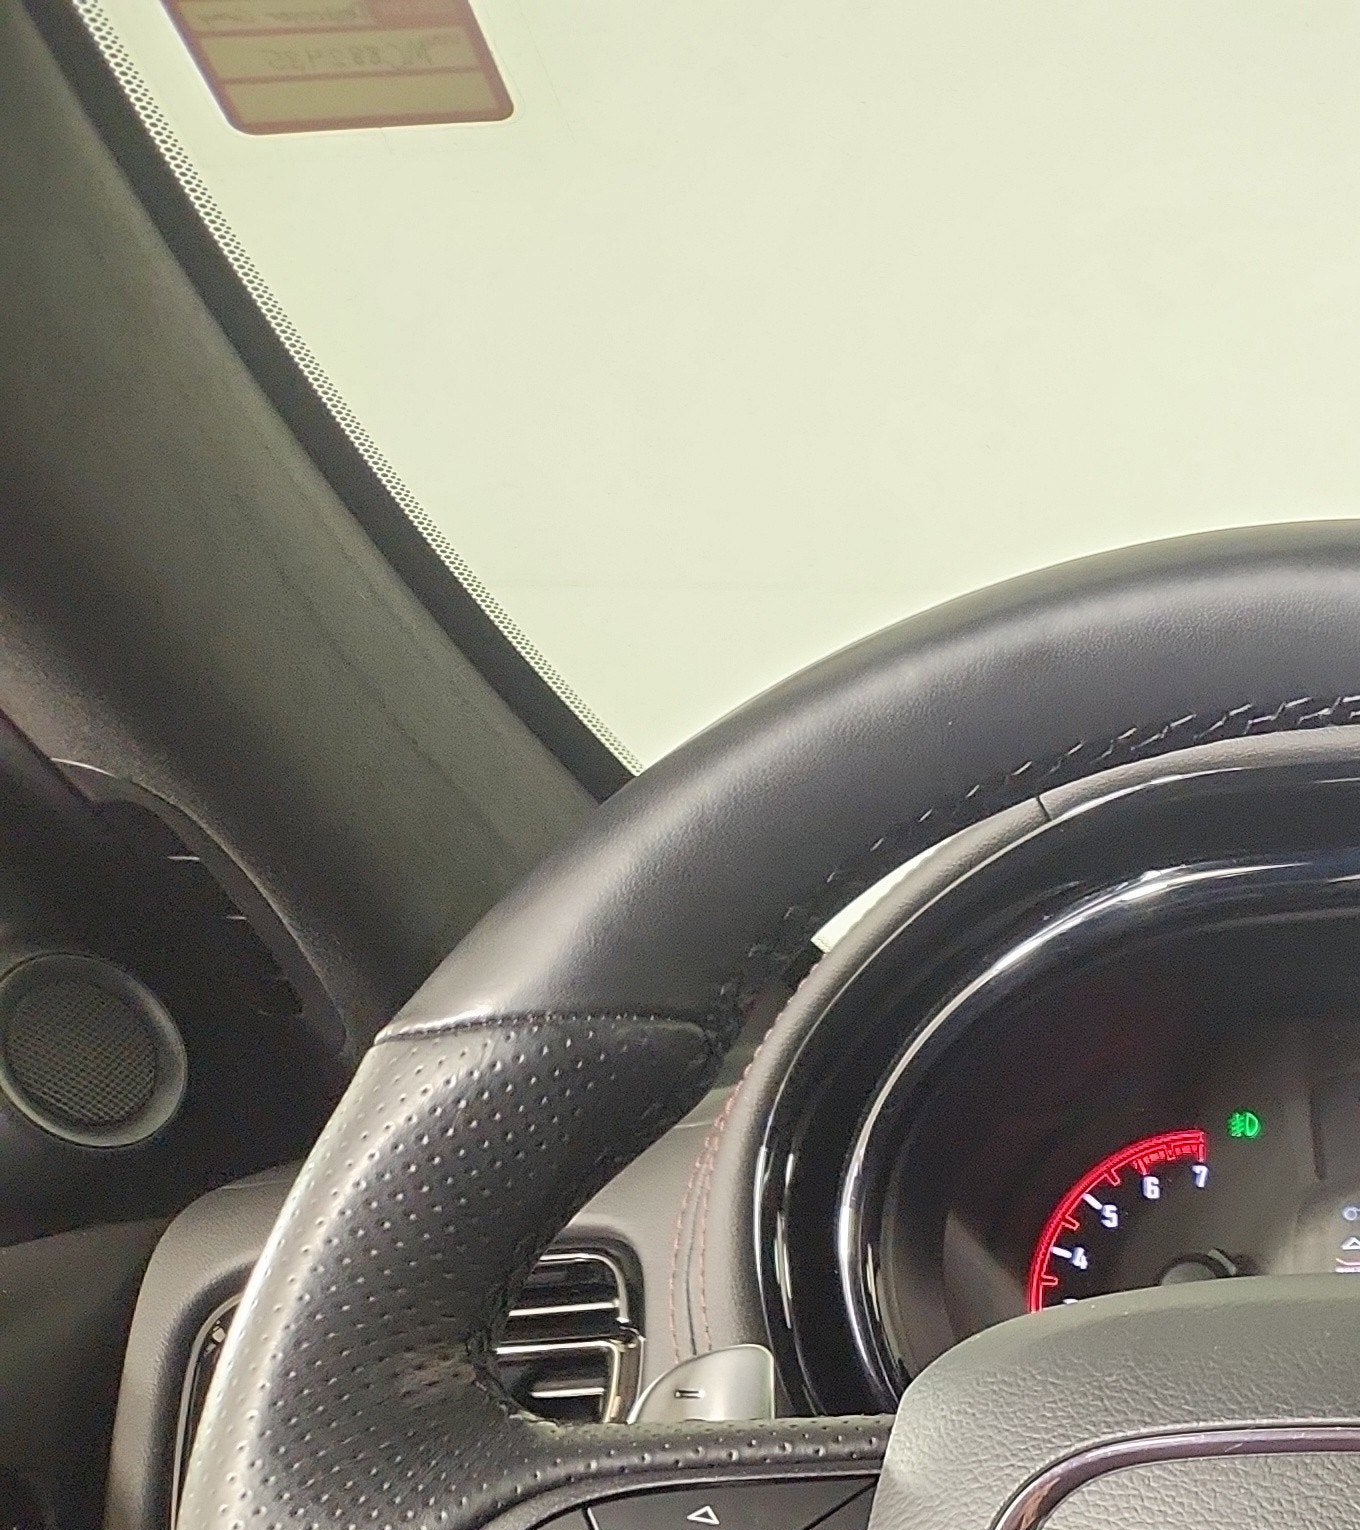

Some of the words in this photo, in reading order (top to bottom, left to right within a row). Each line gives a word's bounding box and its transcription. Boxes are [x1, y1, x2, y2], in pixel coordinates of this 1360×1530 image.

[1142, 1174, 1160, 1199] 6
[1192, 1164, 1209, 1188] 7
[1101, 1204, 1119, 1228] 5
[1071, 1246, 1089, 1270] 4
